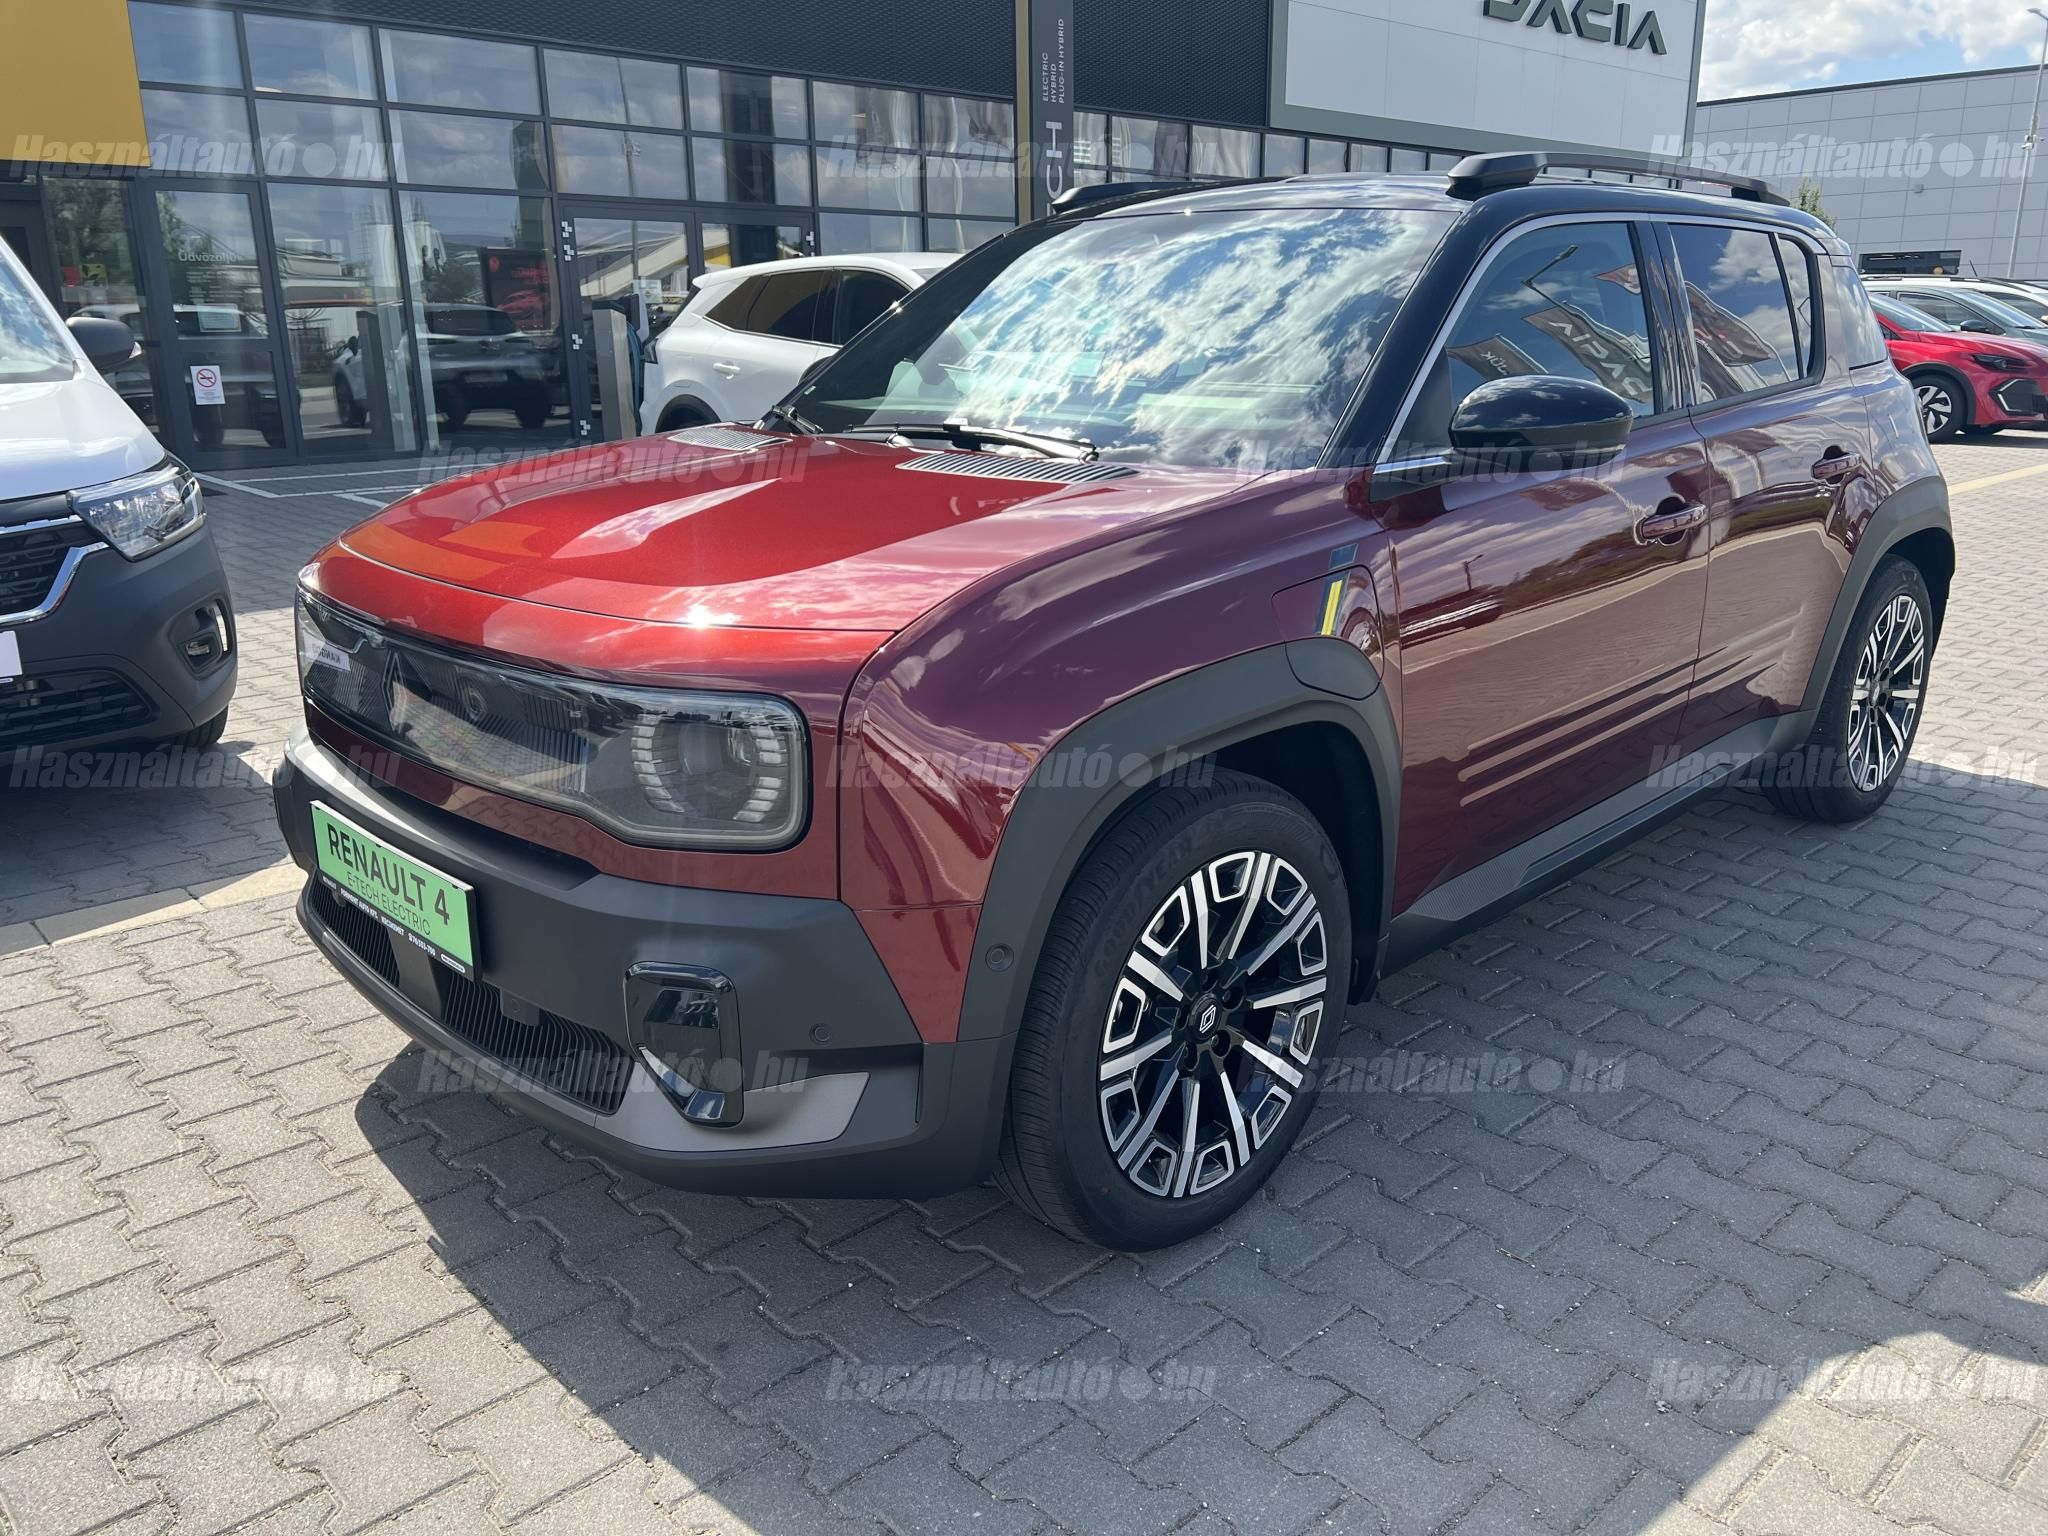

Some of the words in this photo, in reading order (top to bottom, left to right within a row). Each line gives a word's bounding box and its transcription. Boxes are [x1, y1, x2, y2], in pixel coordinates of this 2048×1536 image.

[327, 823, 426, 911] RENAULT
[434, 888, 450, 926] 4
[347, 871, 380, 905] E-TECH
[382, 894, 431, 936] ELECTRIC
